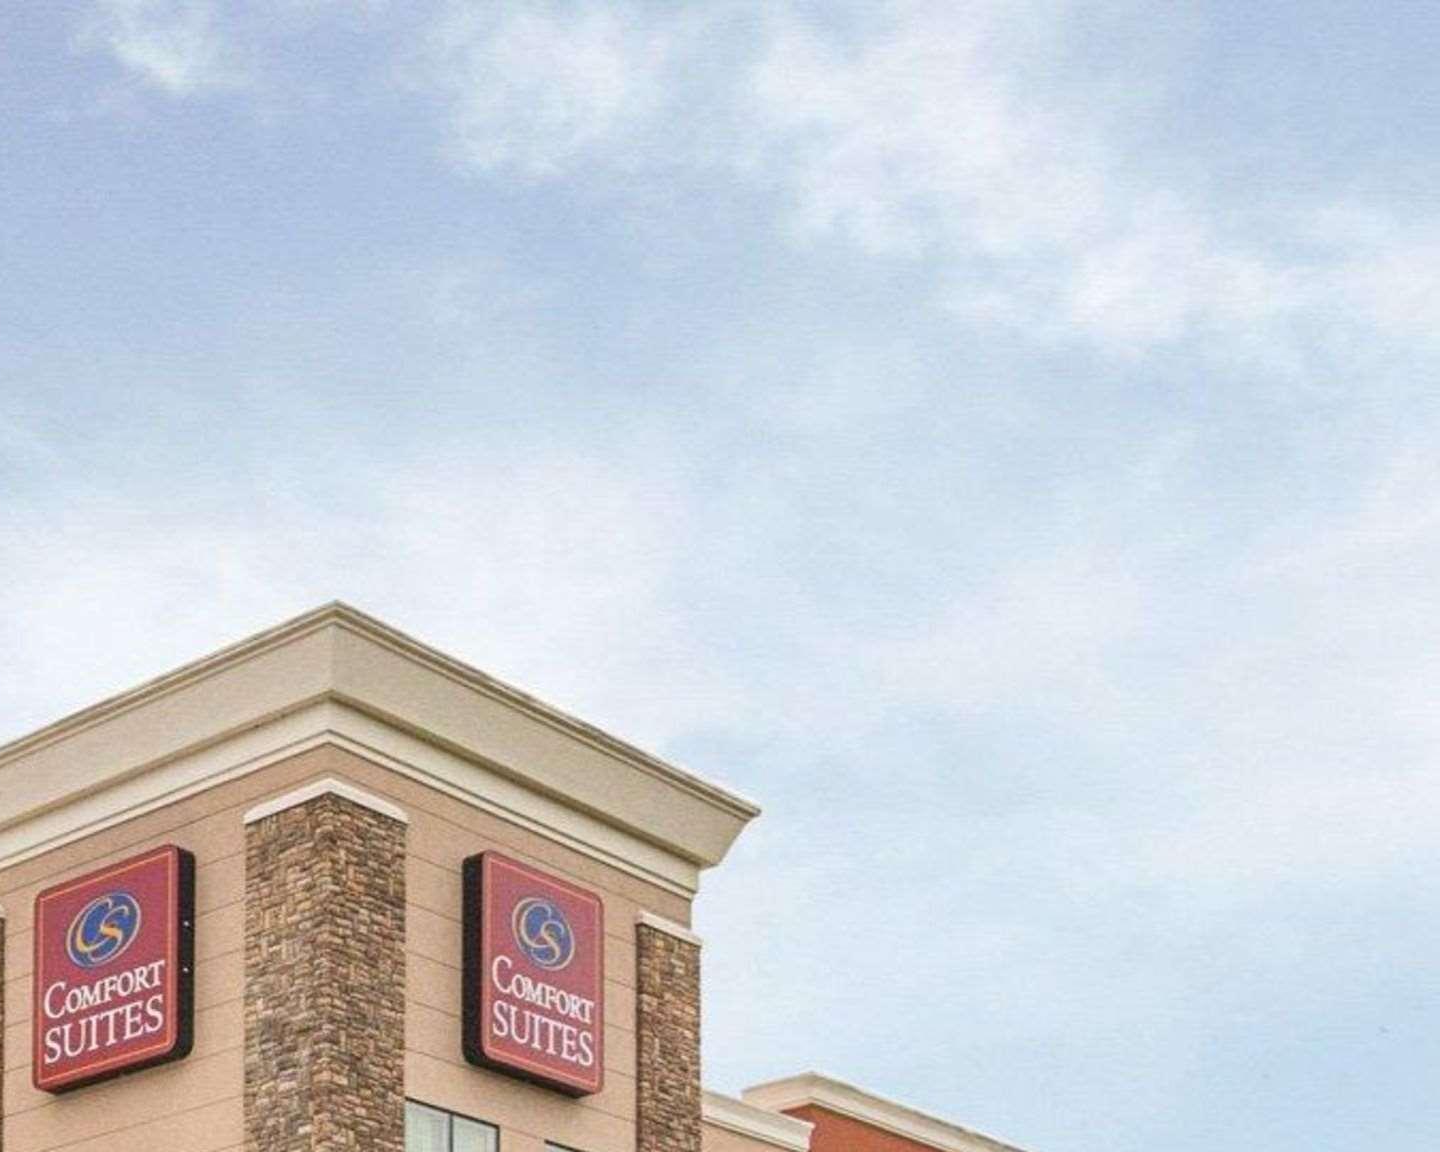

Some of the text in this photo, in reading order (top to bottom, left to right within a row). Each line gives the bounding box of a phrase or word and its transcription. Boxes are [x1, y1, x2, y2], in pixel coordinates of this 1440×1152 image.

[44, 959, 165, 1018] COMFORT
[492, 956, 594, 1024] COMFORT
[44, 995, 164, 1064] SUITES
[492, 1000, 594, 1067] SUITES
